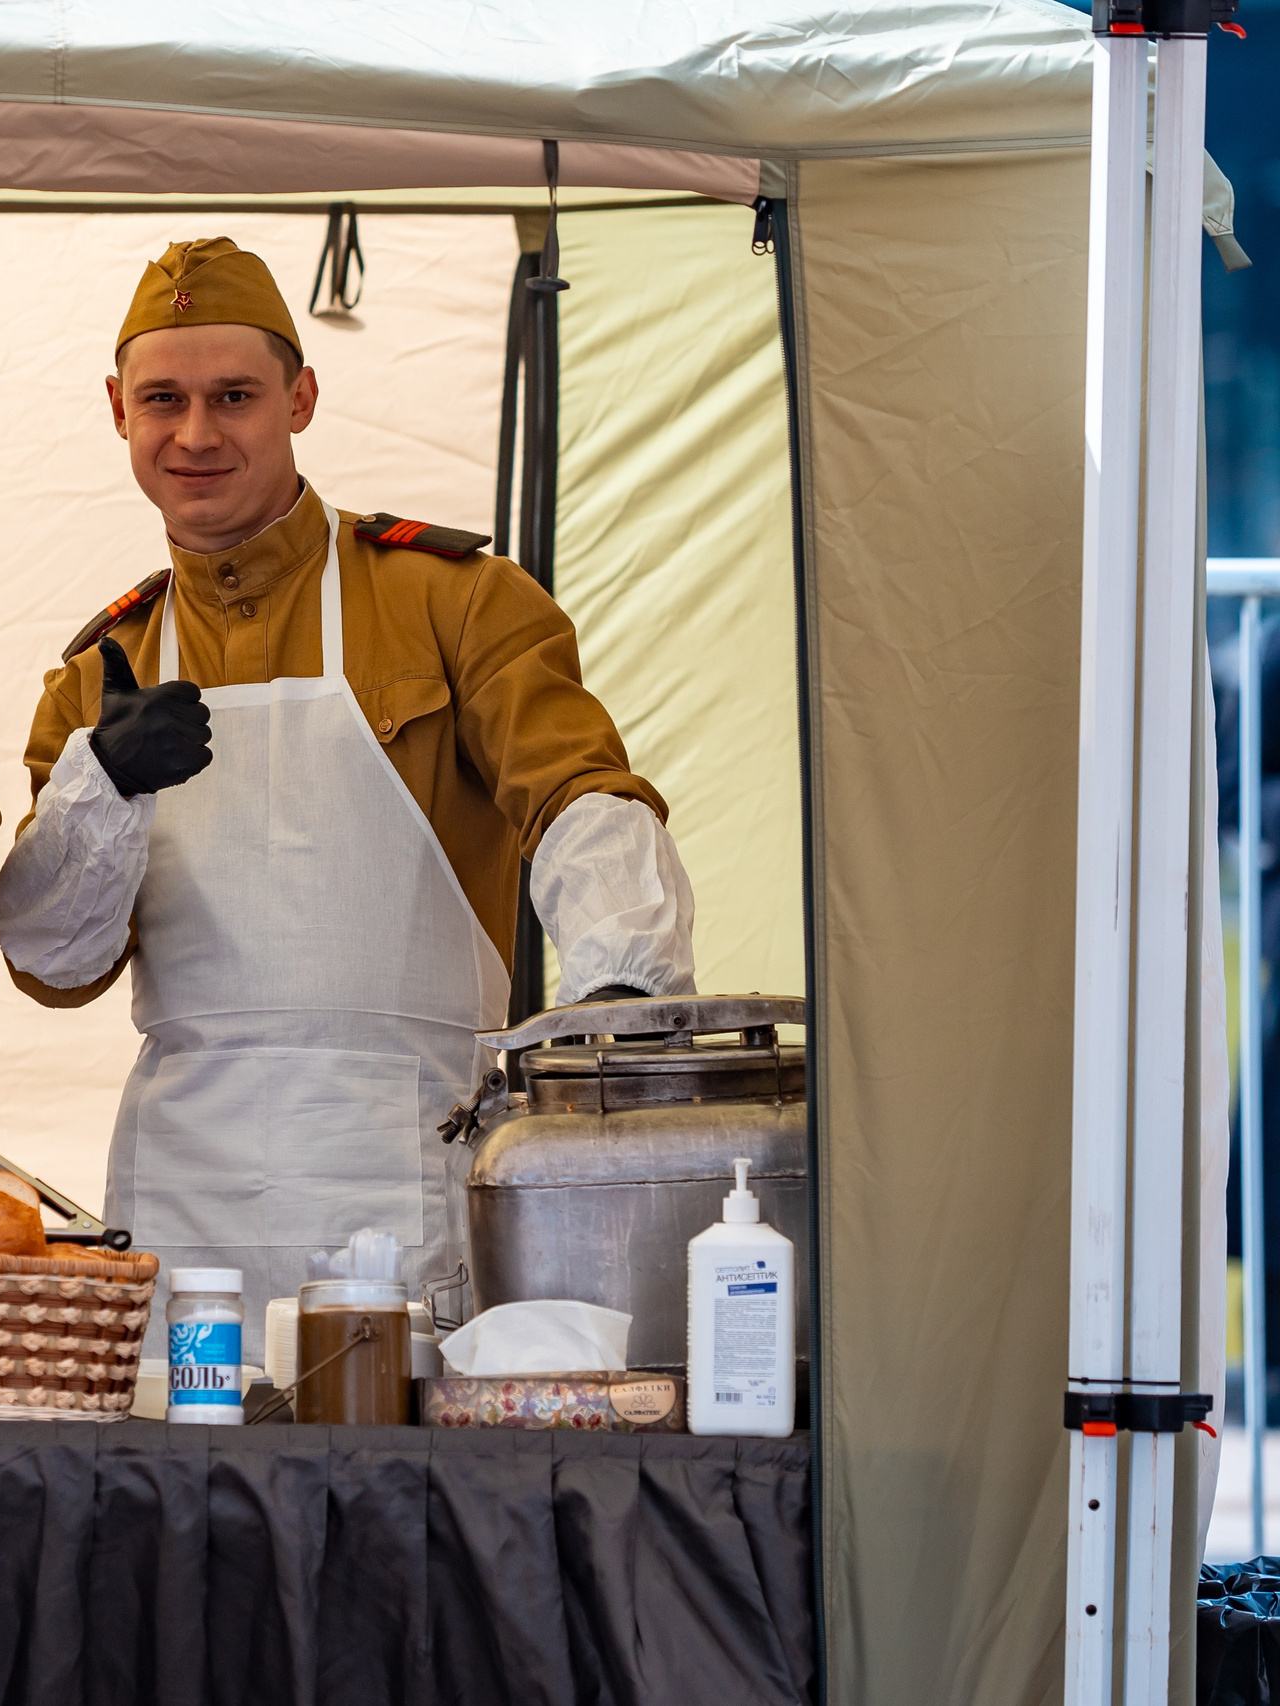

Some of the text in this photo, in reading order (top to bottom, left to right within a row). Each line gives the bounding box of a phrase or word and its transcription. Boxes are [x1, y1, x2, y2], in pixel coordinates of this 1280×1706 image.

[716, 1271, 779, 1283] АНТИСЕПТИК
[171, 1367, 224, 1390] СОЛЬ
[614, 1385, 671, 1394] САЛФЕТКИ
